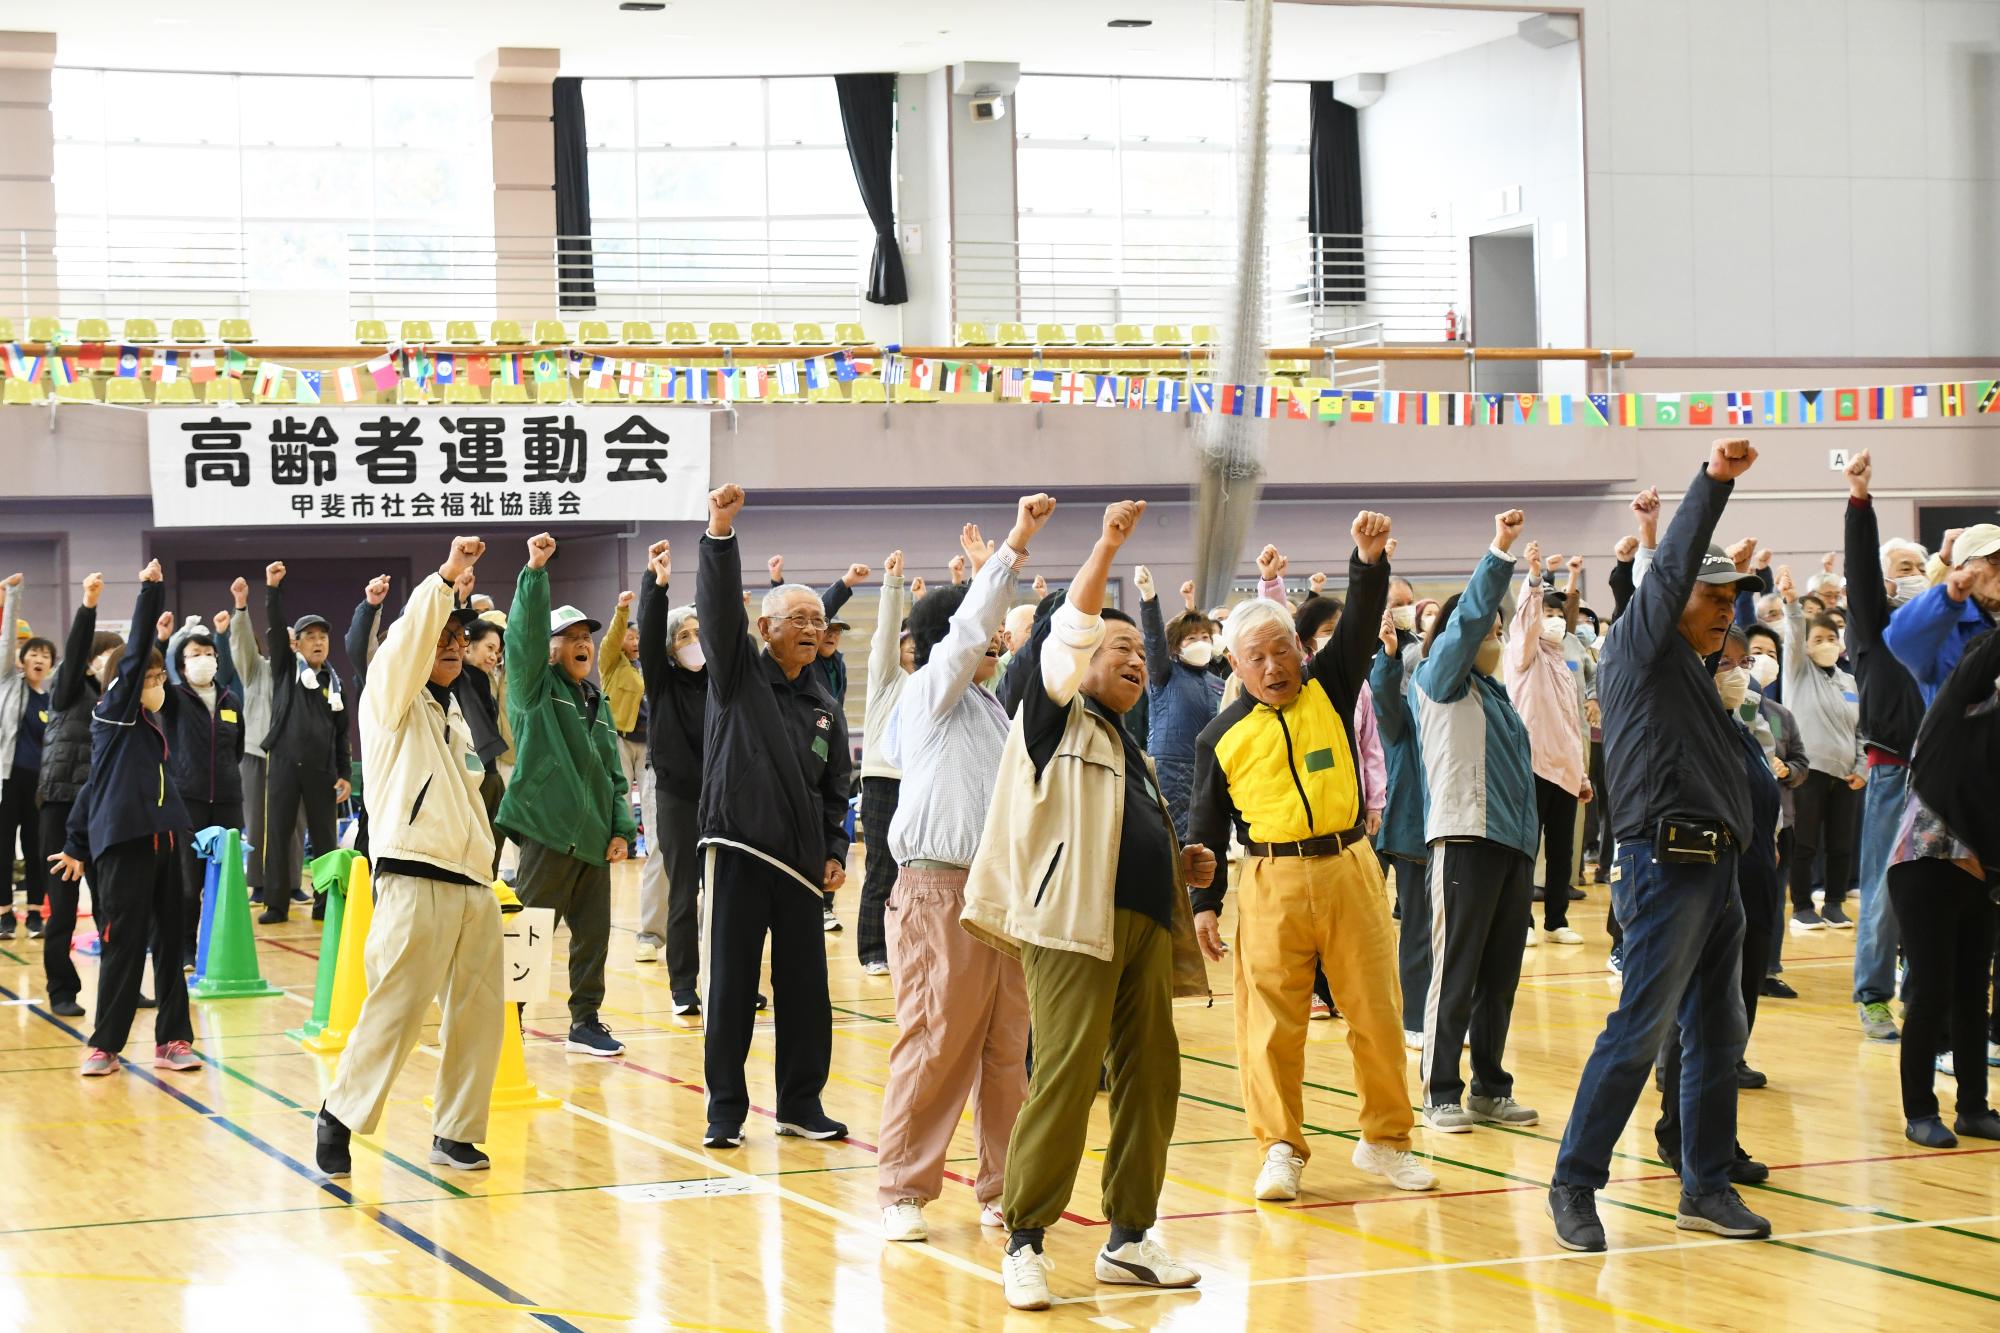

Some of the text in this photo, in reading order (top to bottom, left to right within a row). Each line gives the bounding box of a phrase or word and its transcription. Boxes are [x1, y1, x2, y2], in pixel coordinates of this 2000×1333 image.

[181, 415, 671, 488] 高齢者運動会
[1834, 453, 1844, 466] A
[291, 490, 582, 518] 甲斐市社会福祉協議会
